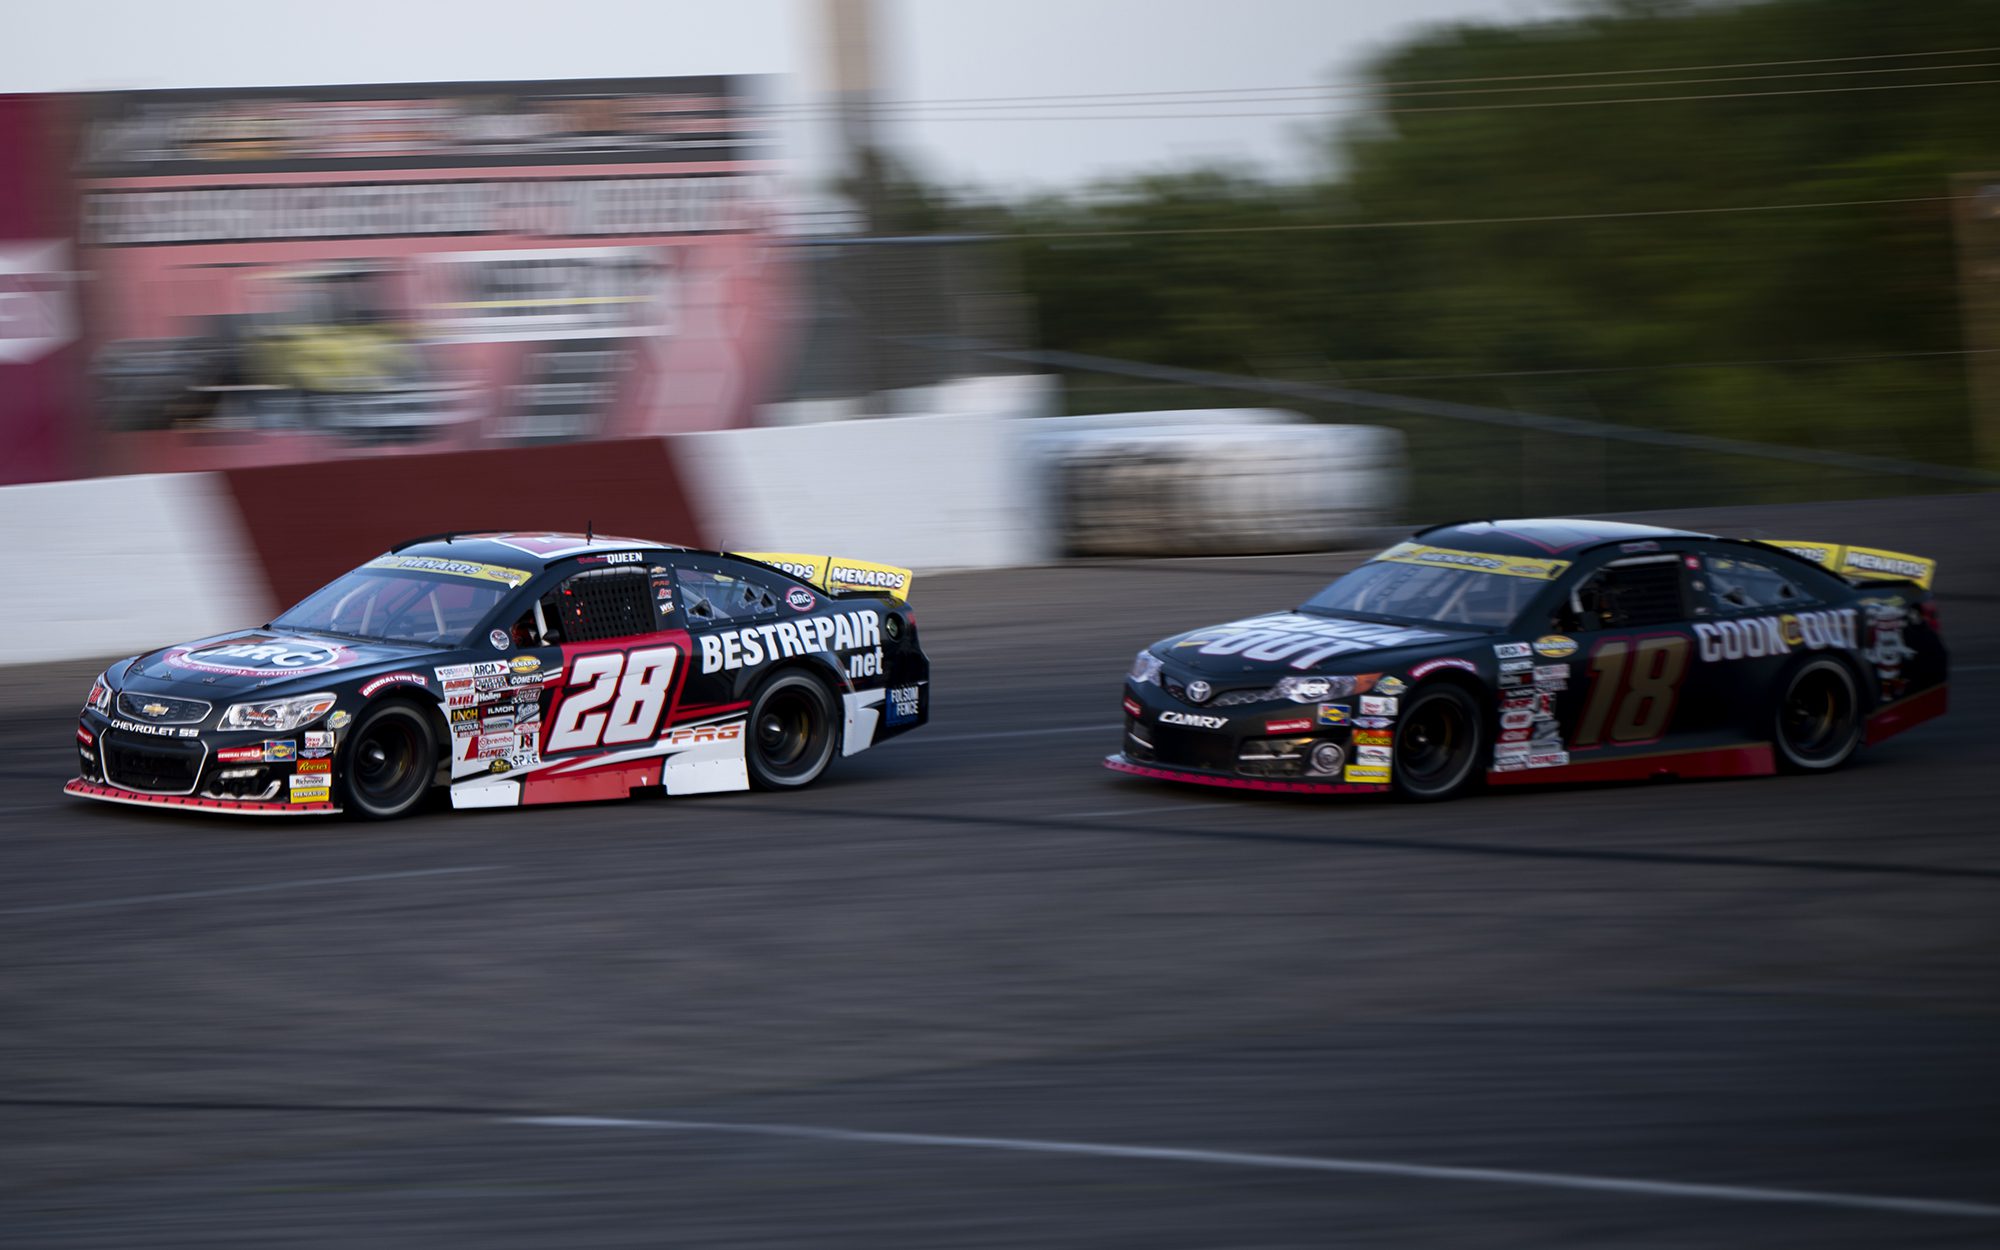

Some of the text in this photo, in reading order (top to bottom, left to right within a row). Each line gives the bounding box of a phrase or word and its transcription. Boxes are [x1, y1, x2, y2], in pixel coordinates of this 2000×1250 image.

[606, 551, 643, 564] QUEEN
[1844, 549, 1930, 577] MENARDS
[399, 558, 483, 576] MENARDS
[831, 566, 906, 589] MENARDS
[790, 593, 812, 605] BRC
[699, 609, 883, 675] BESTREPAIR
[1692, 614, 1792, 663] COOK
[1794, 607, 1858, 651] OUT
[474, 663, 497, 676] ARCA
[845, 645, 884, 680] .net
[362, 676, 396, 697] GENERAL
[511, 675, 542, 685] COMETIC
[546, 645, 678, 752] 28
[890, 686, 919, 703] FOLSOM
[1571, 635, 1690, 746] 18
[453, 709, 478, 721] UNOH
[488, 705, 515, 715] ILMOR
[895, 701, 919, 717] FENCE
[110, 719, 176, 737] CHEVROLET
[178, 727, 200, 738] SS
[454, 724, 479, 733] LINCOLN
[1158, 711, 1229, 729] CAMRY
[486, 738, 513, 747] brembo
[670, 724, 742, 745] PRG
[296, 776, 323, 785] Richmond
